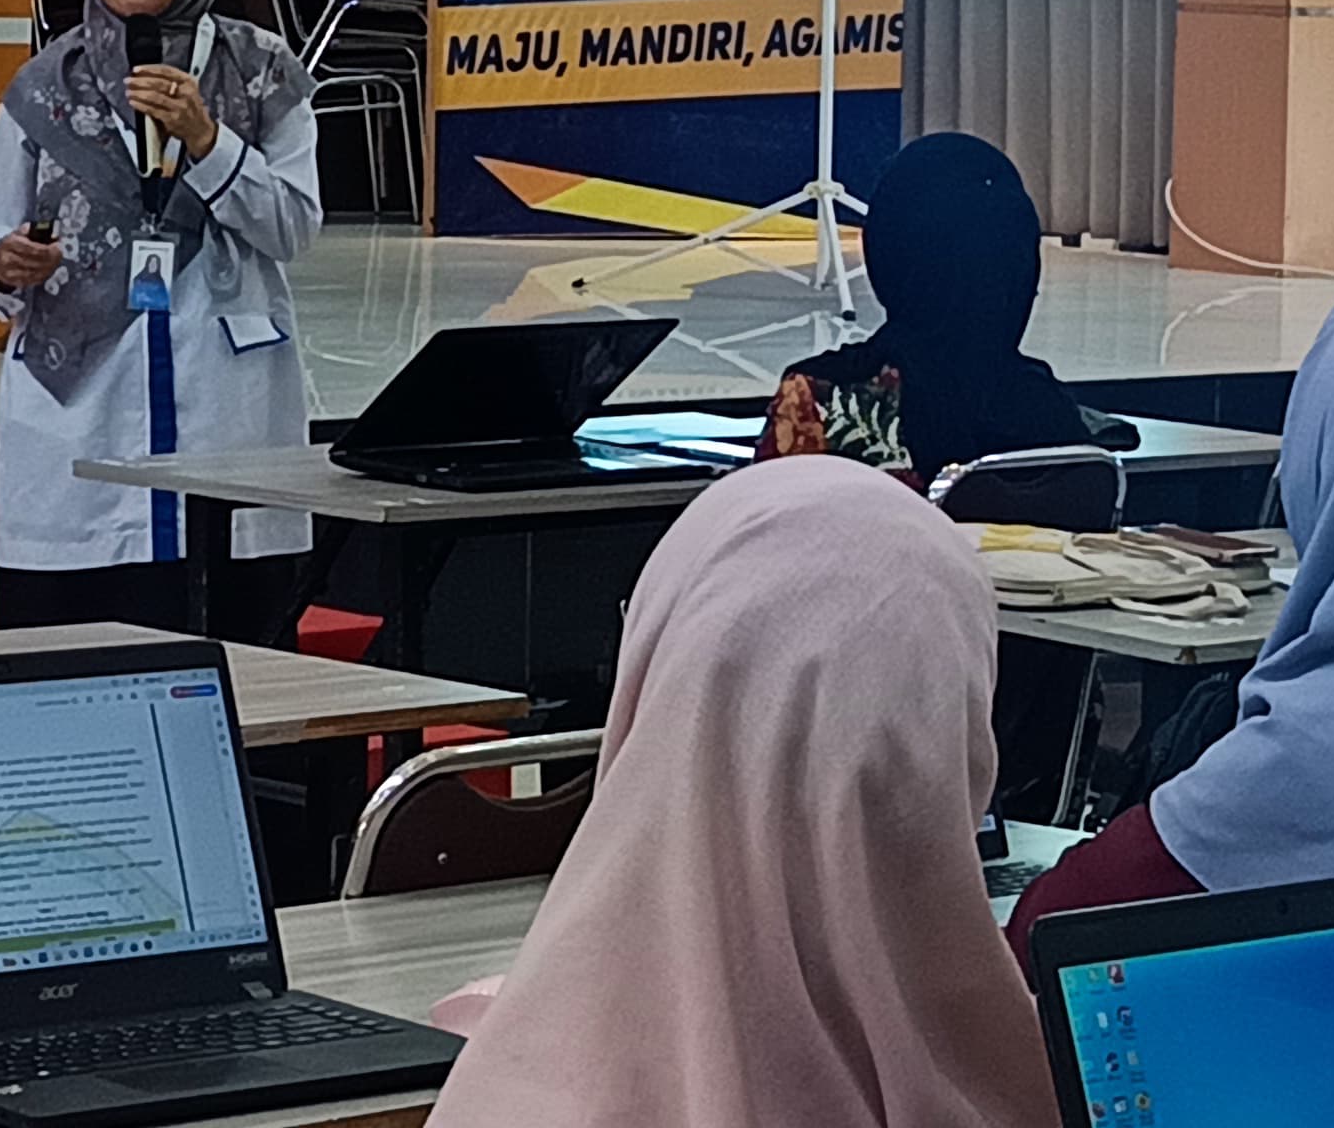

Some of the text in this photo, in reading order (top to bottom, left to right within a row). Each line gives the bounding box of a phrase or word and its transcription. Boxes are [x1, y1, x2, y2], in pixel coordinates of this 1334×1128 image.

[446, 29, 568, 78] MAJU,
[578, 20, 755, 68] MANDIRI,
[38, 981, 80, 1001] acer
